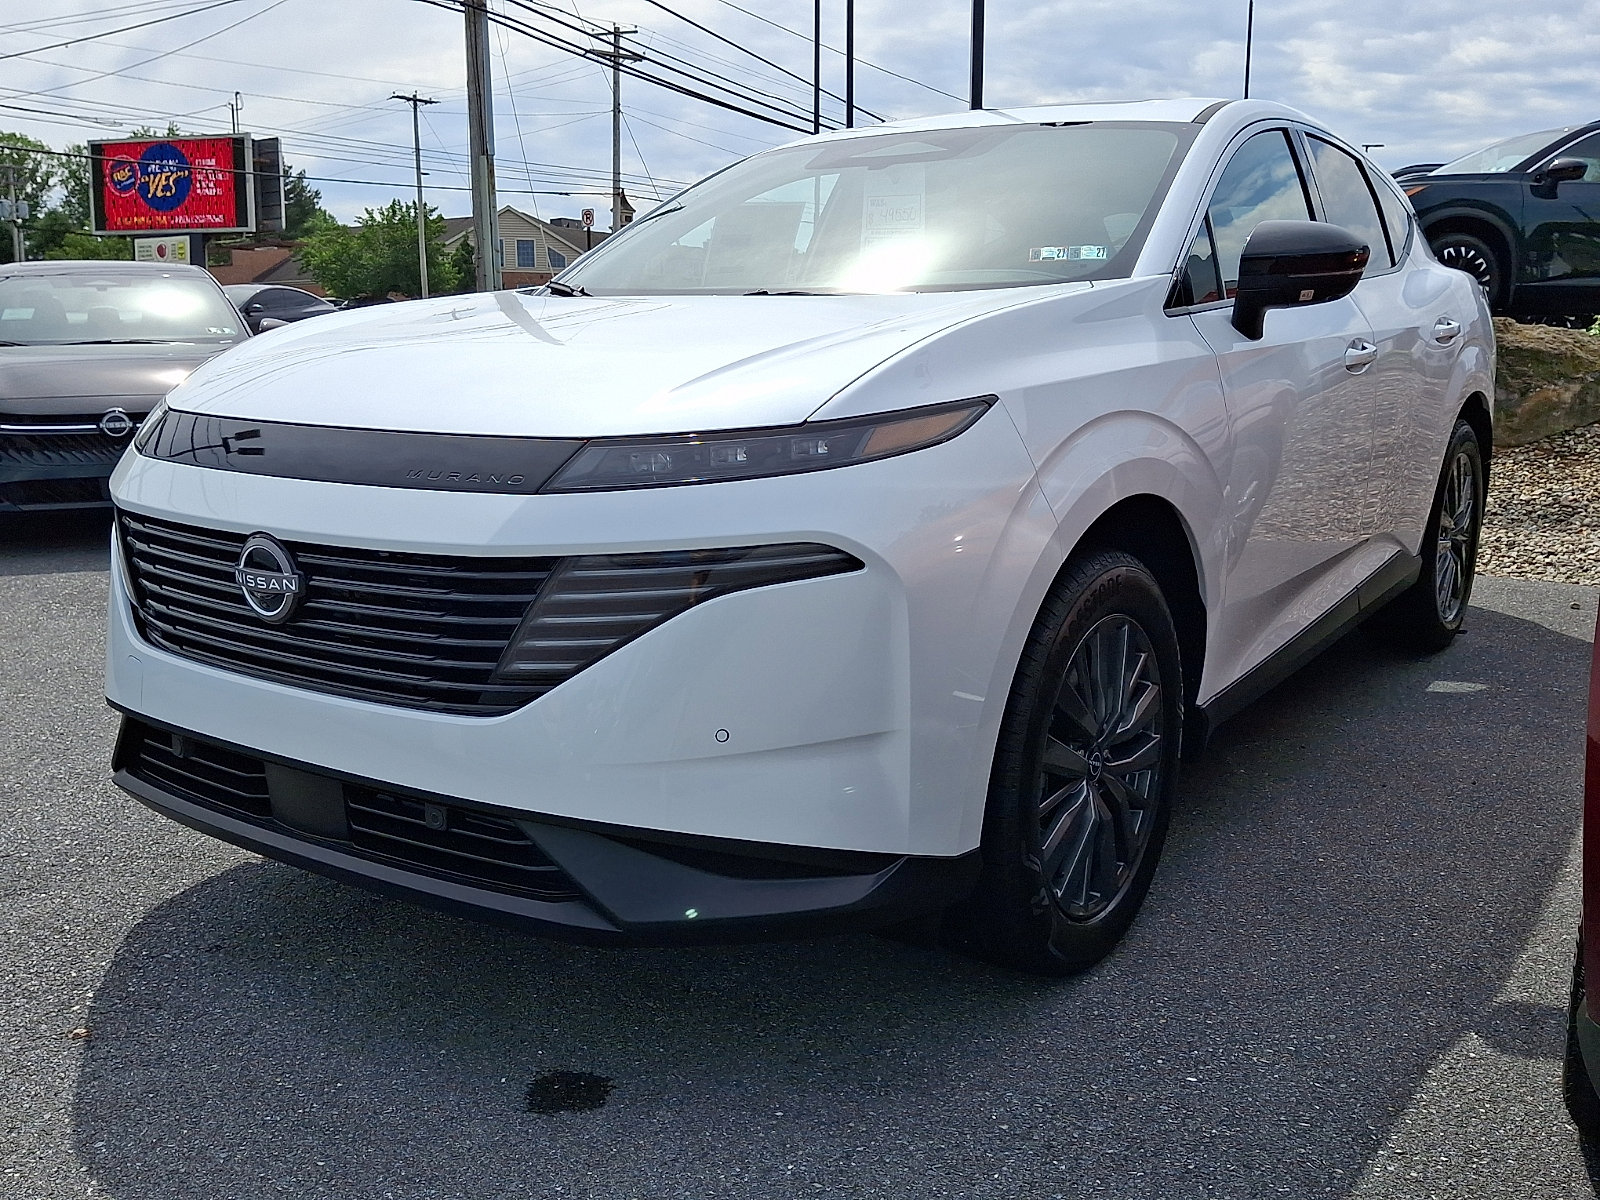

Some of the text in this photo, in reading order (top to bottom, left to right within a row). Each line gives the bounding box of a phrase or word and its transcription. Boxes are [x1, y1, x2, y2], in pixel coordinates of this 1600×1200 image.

[1056, 248, 1066, 259] 27
[1096, 247, 1106, 258] 27
[406, 469, 526, 485] MURANO
[235, 569, 296, 591] NISSAN
